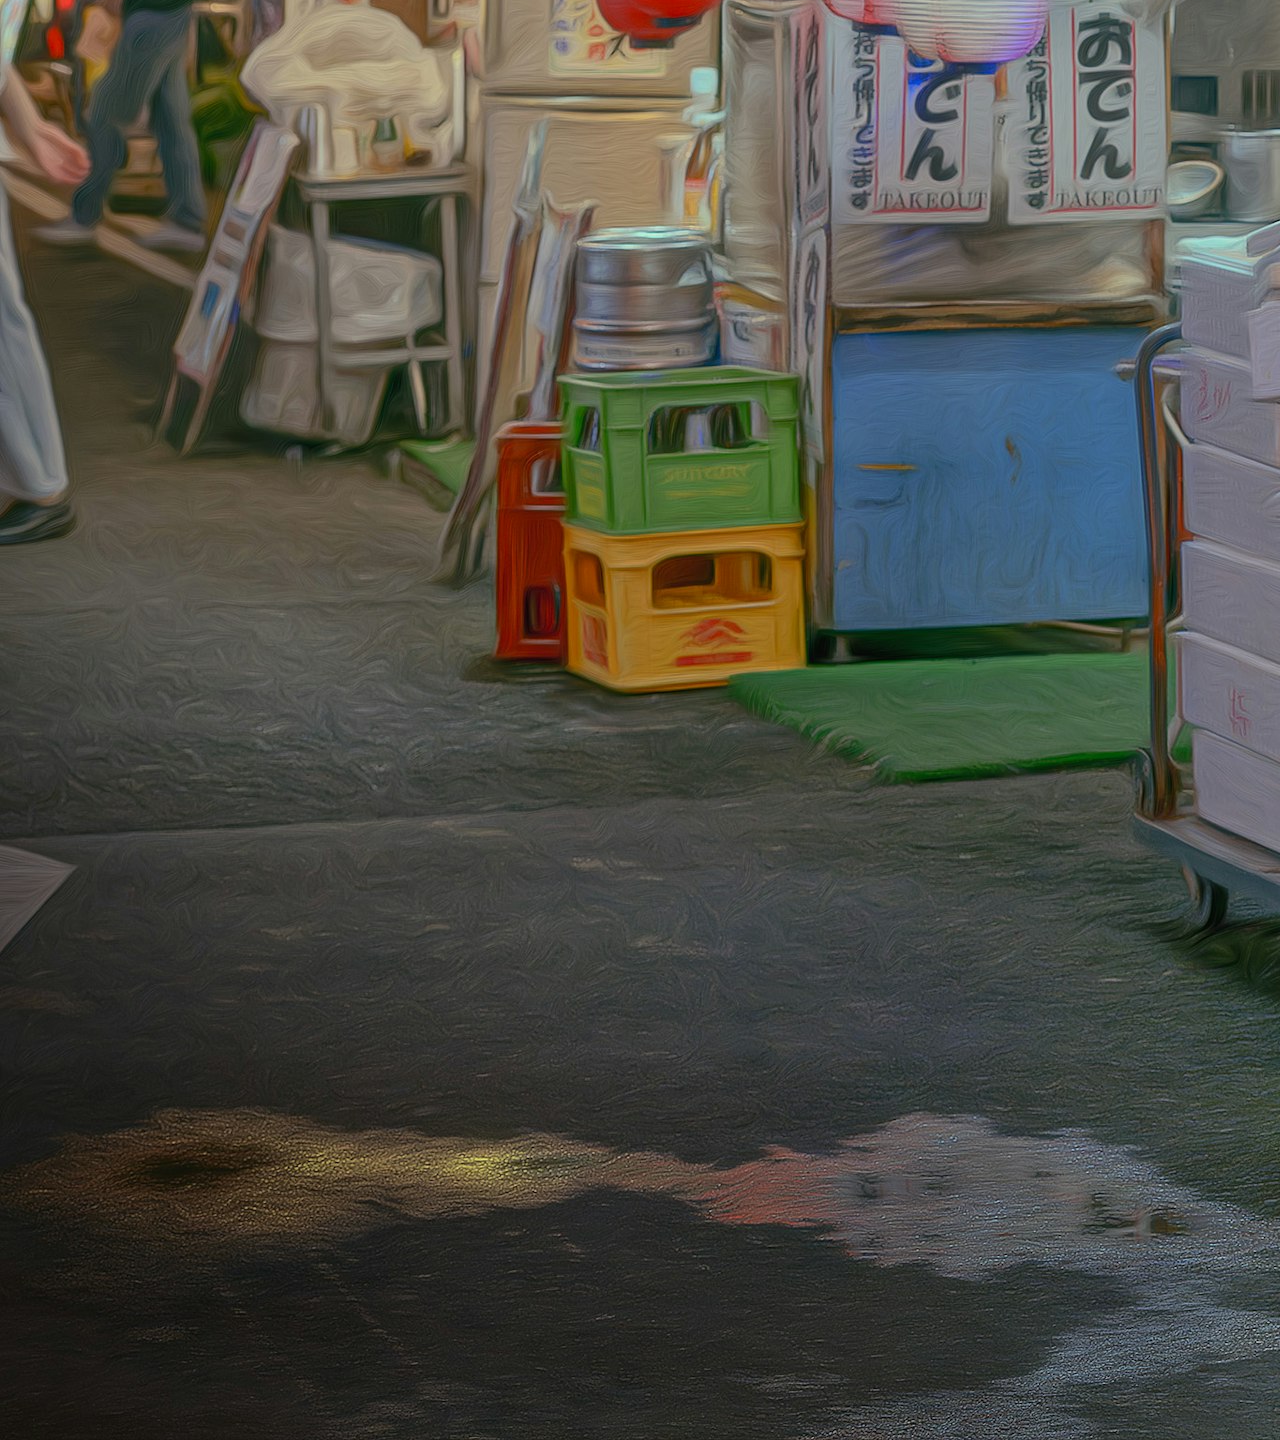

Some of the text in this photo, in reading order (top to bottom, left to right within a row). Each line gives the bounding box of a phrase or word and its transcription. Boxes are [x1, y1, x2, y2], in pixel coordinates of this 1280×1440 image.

[904, 50, 962, 181] でん
[1078, 12, 1133, 180] おでん
[879, 190, 988, 210] TAKEOUT
[1056, 188, 1162, 208] TAKEOUT
